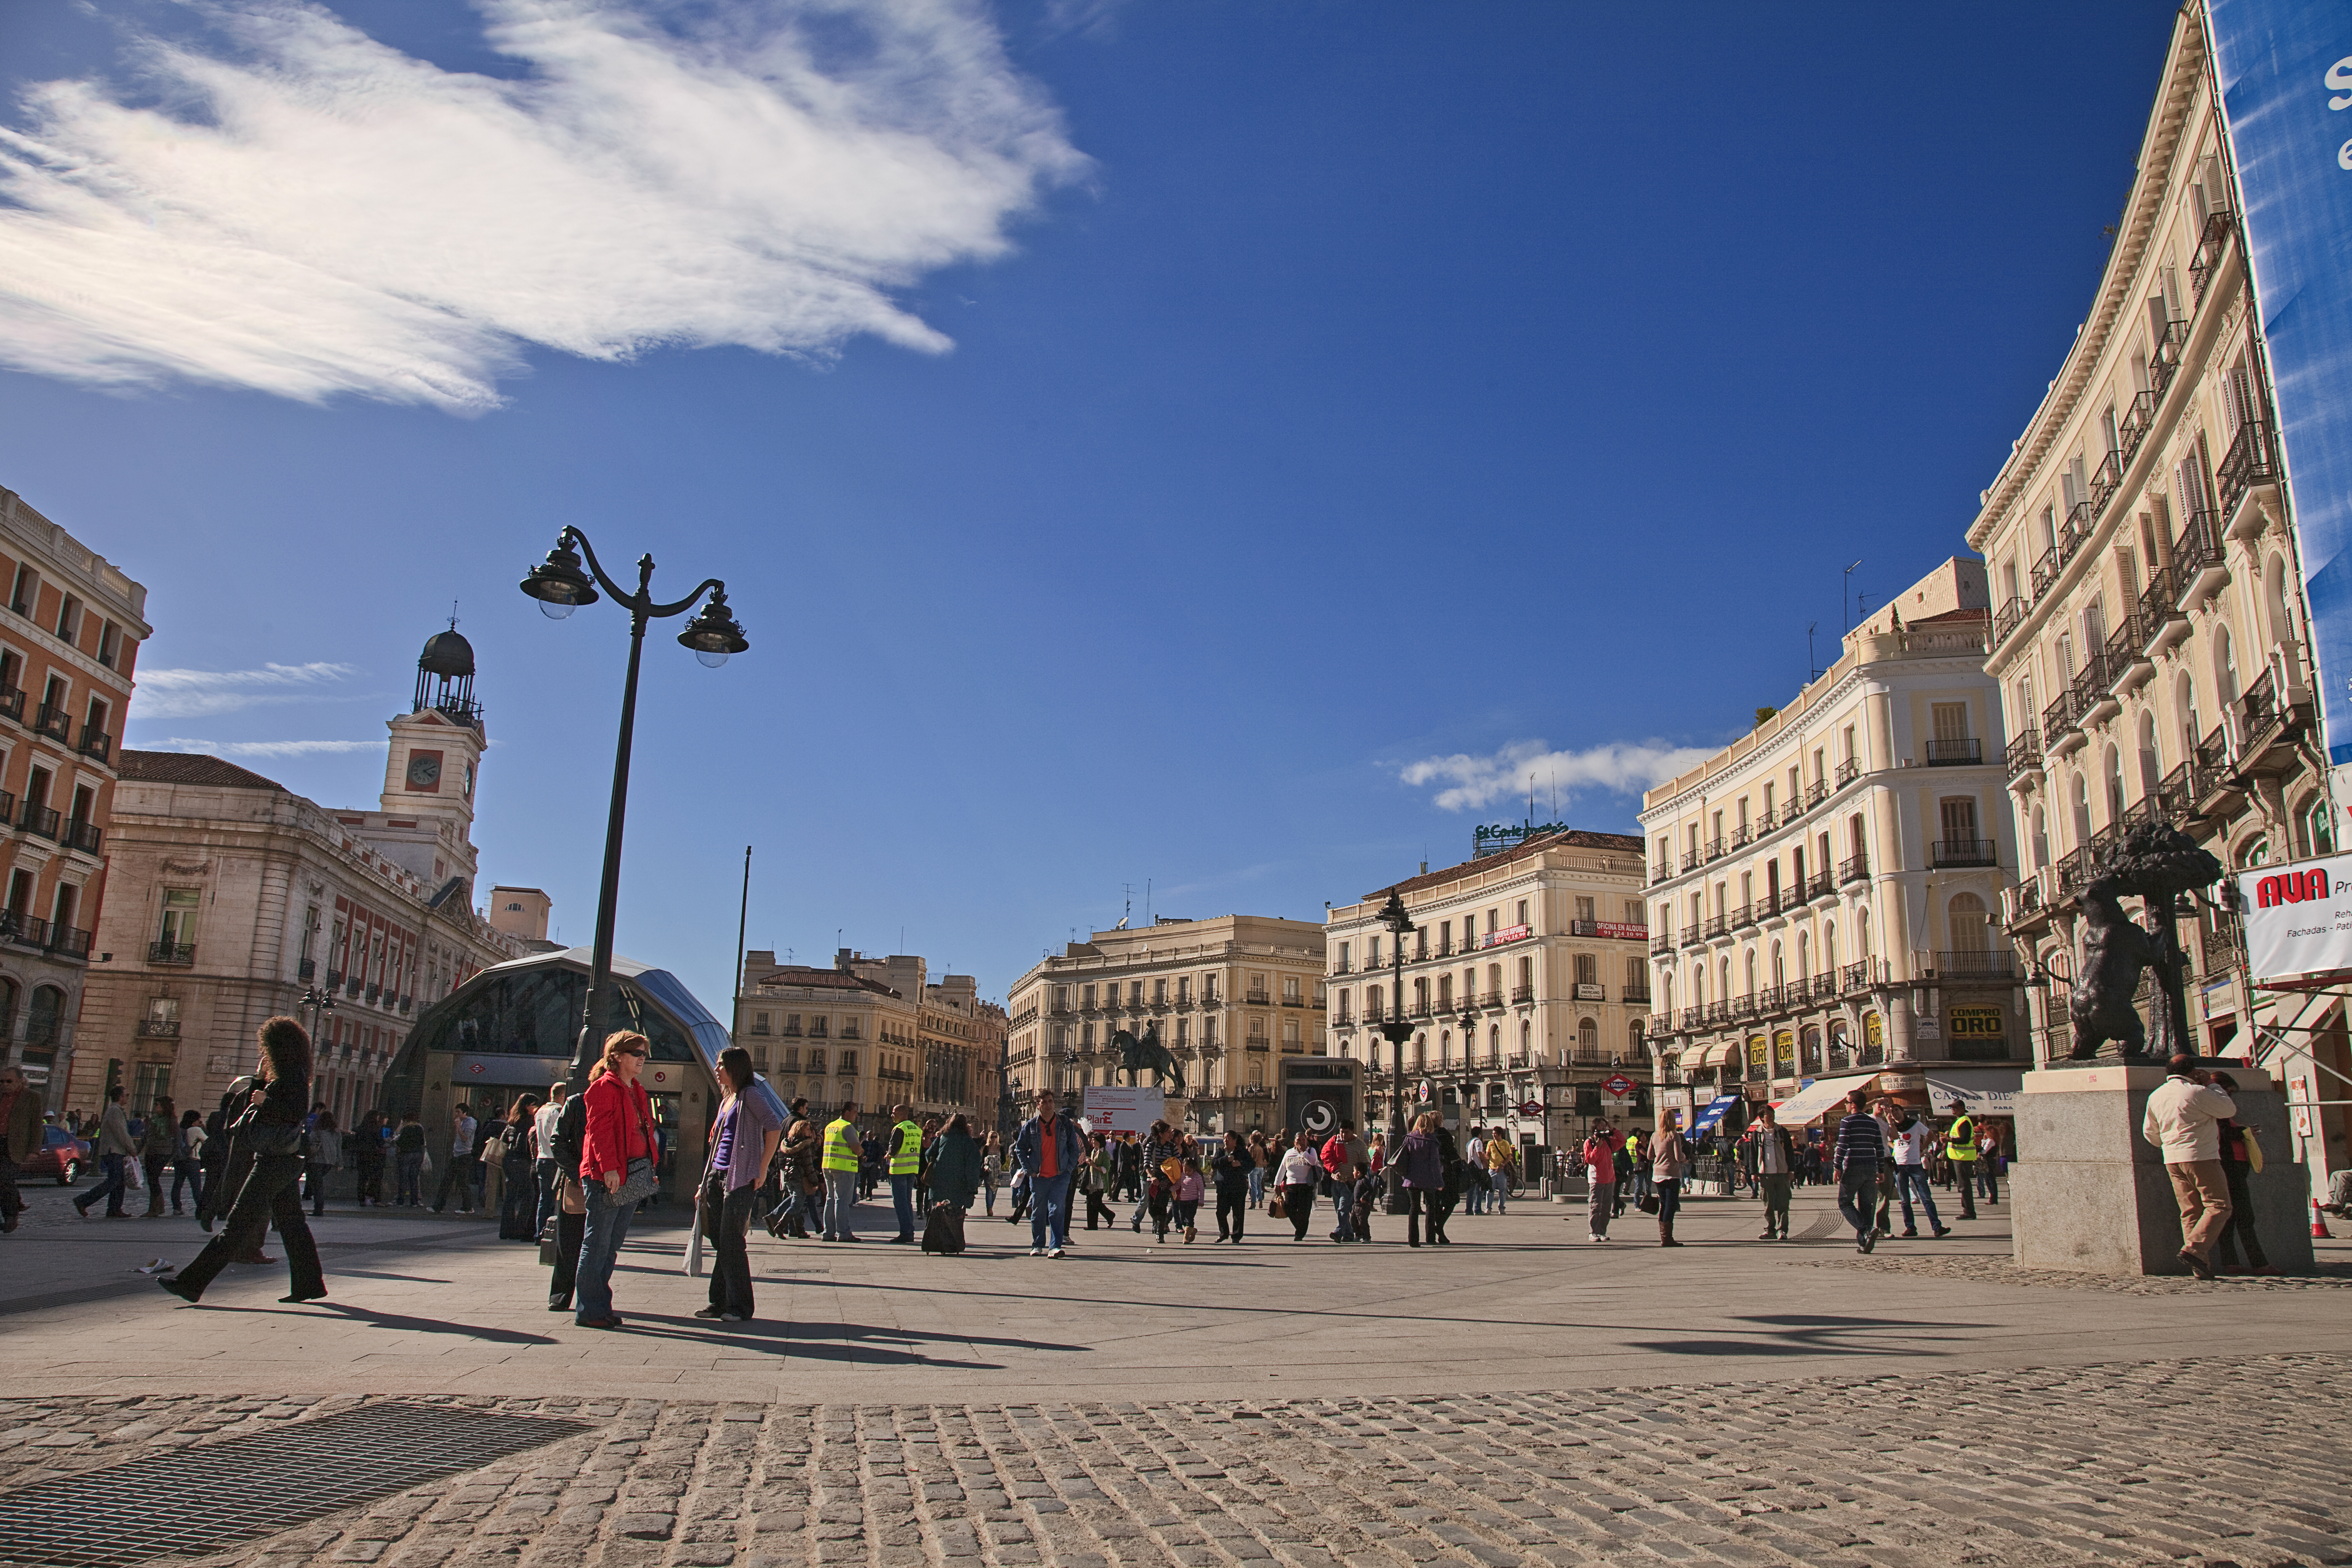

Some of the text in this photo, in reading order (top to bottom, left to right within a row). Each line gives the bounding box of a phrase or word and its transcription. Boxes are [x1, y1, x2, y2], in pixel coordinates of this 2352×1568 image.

[1475, 825, 1490, 840] El
[1491, 824, 1522, 838] Corte
[2257, 868, 2329, 908] AVA
[2335, 881, 2352, 894] Pr
[2335, 910, 2352, 919] Reh
[1509, 924, 1526, 935] DISPONIBLE
[2287, 926, 2326, 937] Fachadas
[1951, 1017, 2001, 1033] ORO
[1144, 1088, 1164, 1101] 20
[1933, 1092, 1970, 1100] CASA
[1987, 1091, 2020, 1100] DIE
